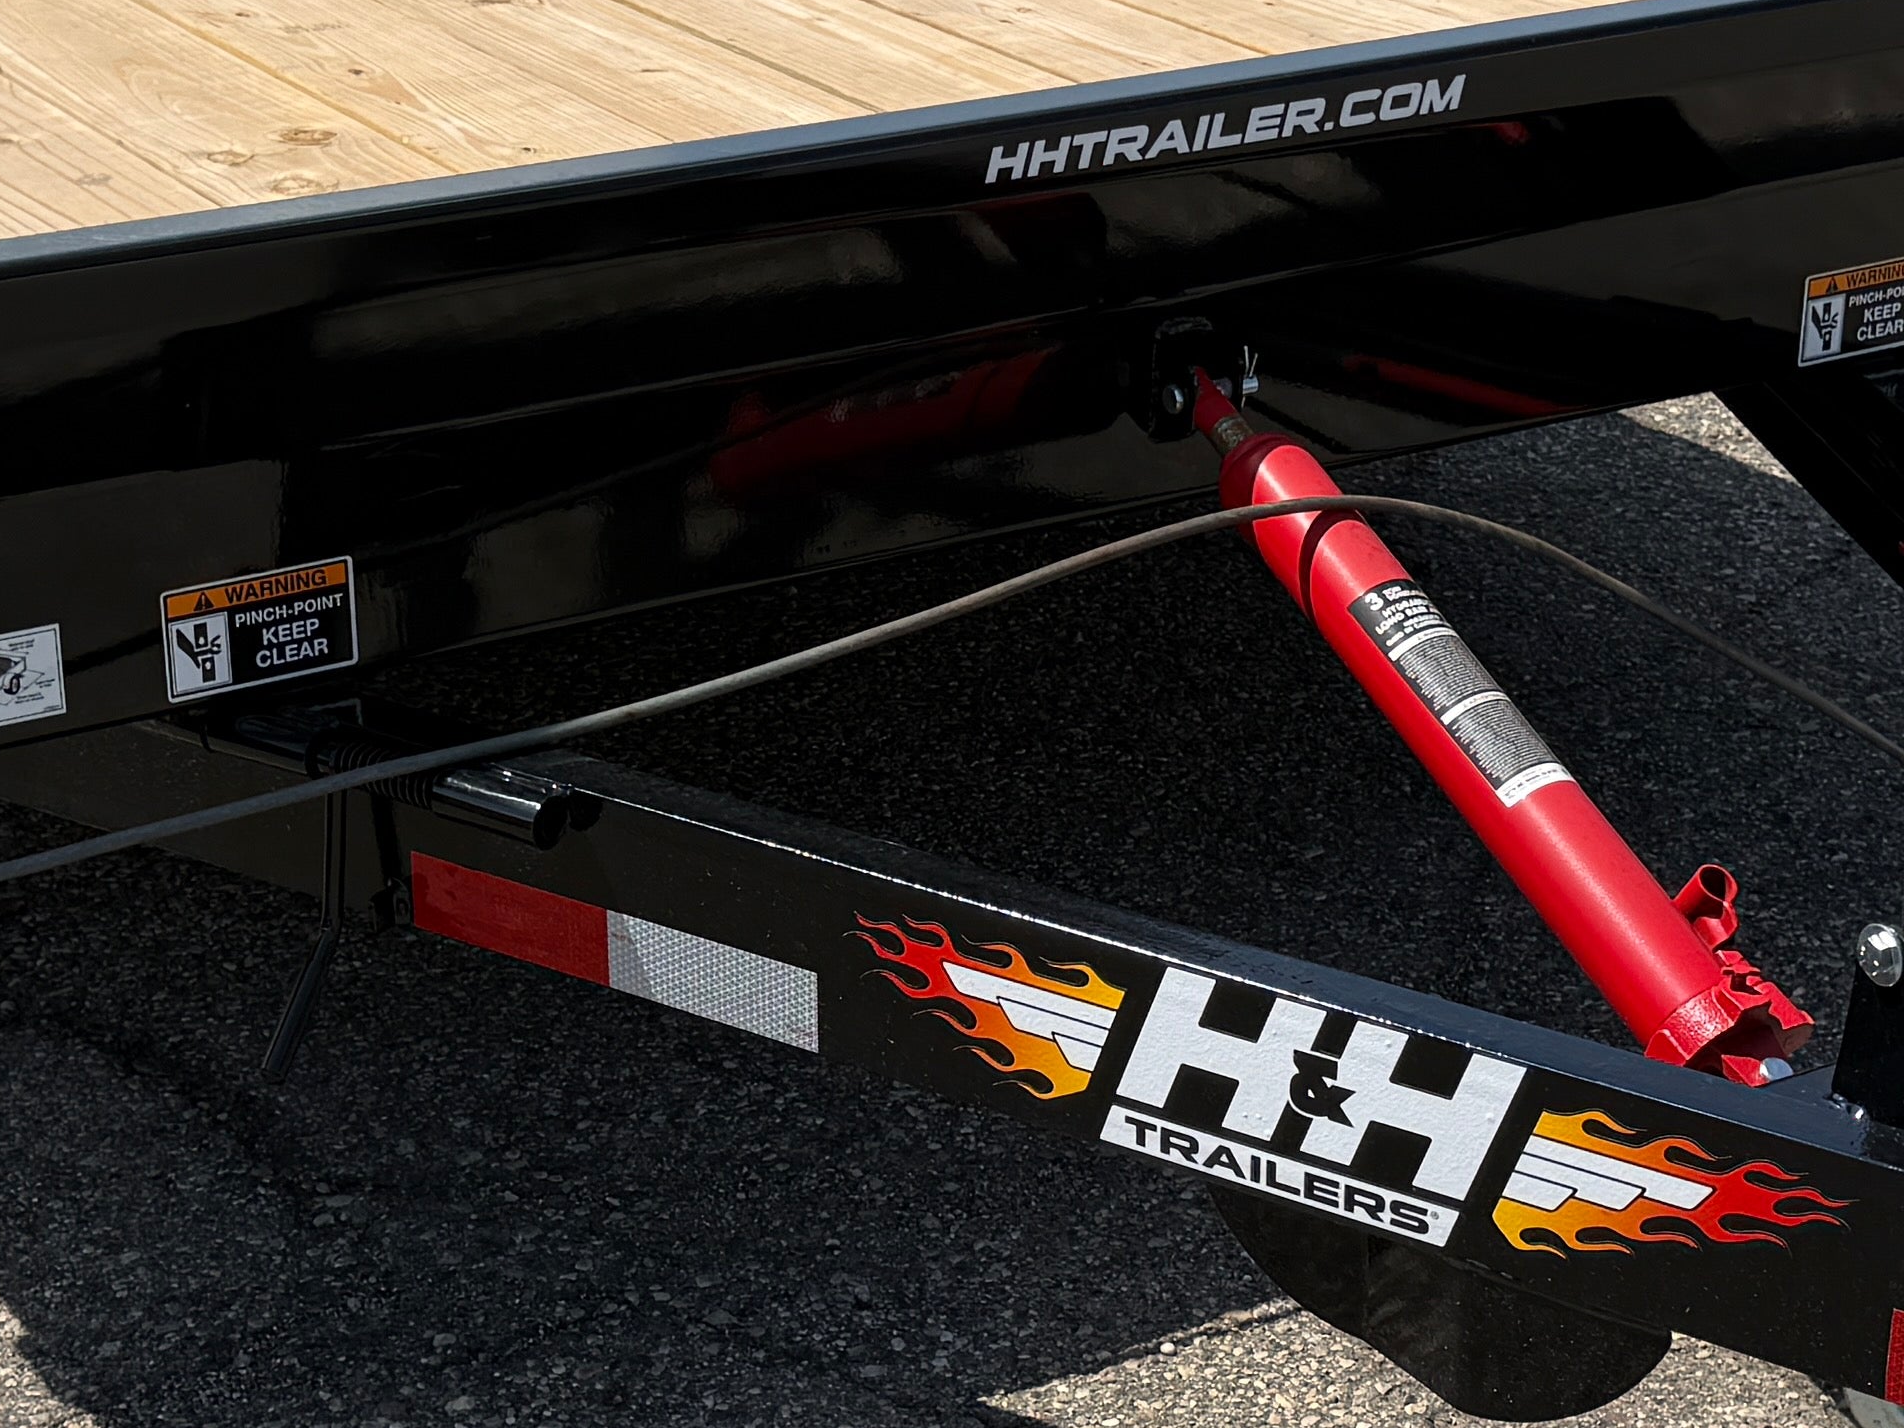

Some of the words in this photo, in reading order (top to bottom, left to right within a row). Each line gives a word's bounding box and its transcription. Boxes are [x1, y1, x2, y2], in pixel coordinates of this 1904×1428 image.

[984, 74, 1467, 184] HHTRAILER.COM
[1863, 302, 1902, 323] KEEP
[1856, 318, 1904, 342] CLEAR
[224, 568, 327, 604] WARNING
[1364, 592, 1385, 611] 3
[234, 592, 344, 628] PINCH-POINT
[262, 618, 320, 646] KEEP
[255, 637, 329, 668] CLEAR
[1115, 966, 1528, 1202] H&H
[1124, 1115, 1431, 1237] TRAILERS
